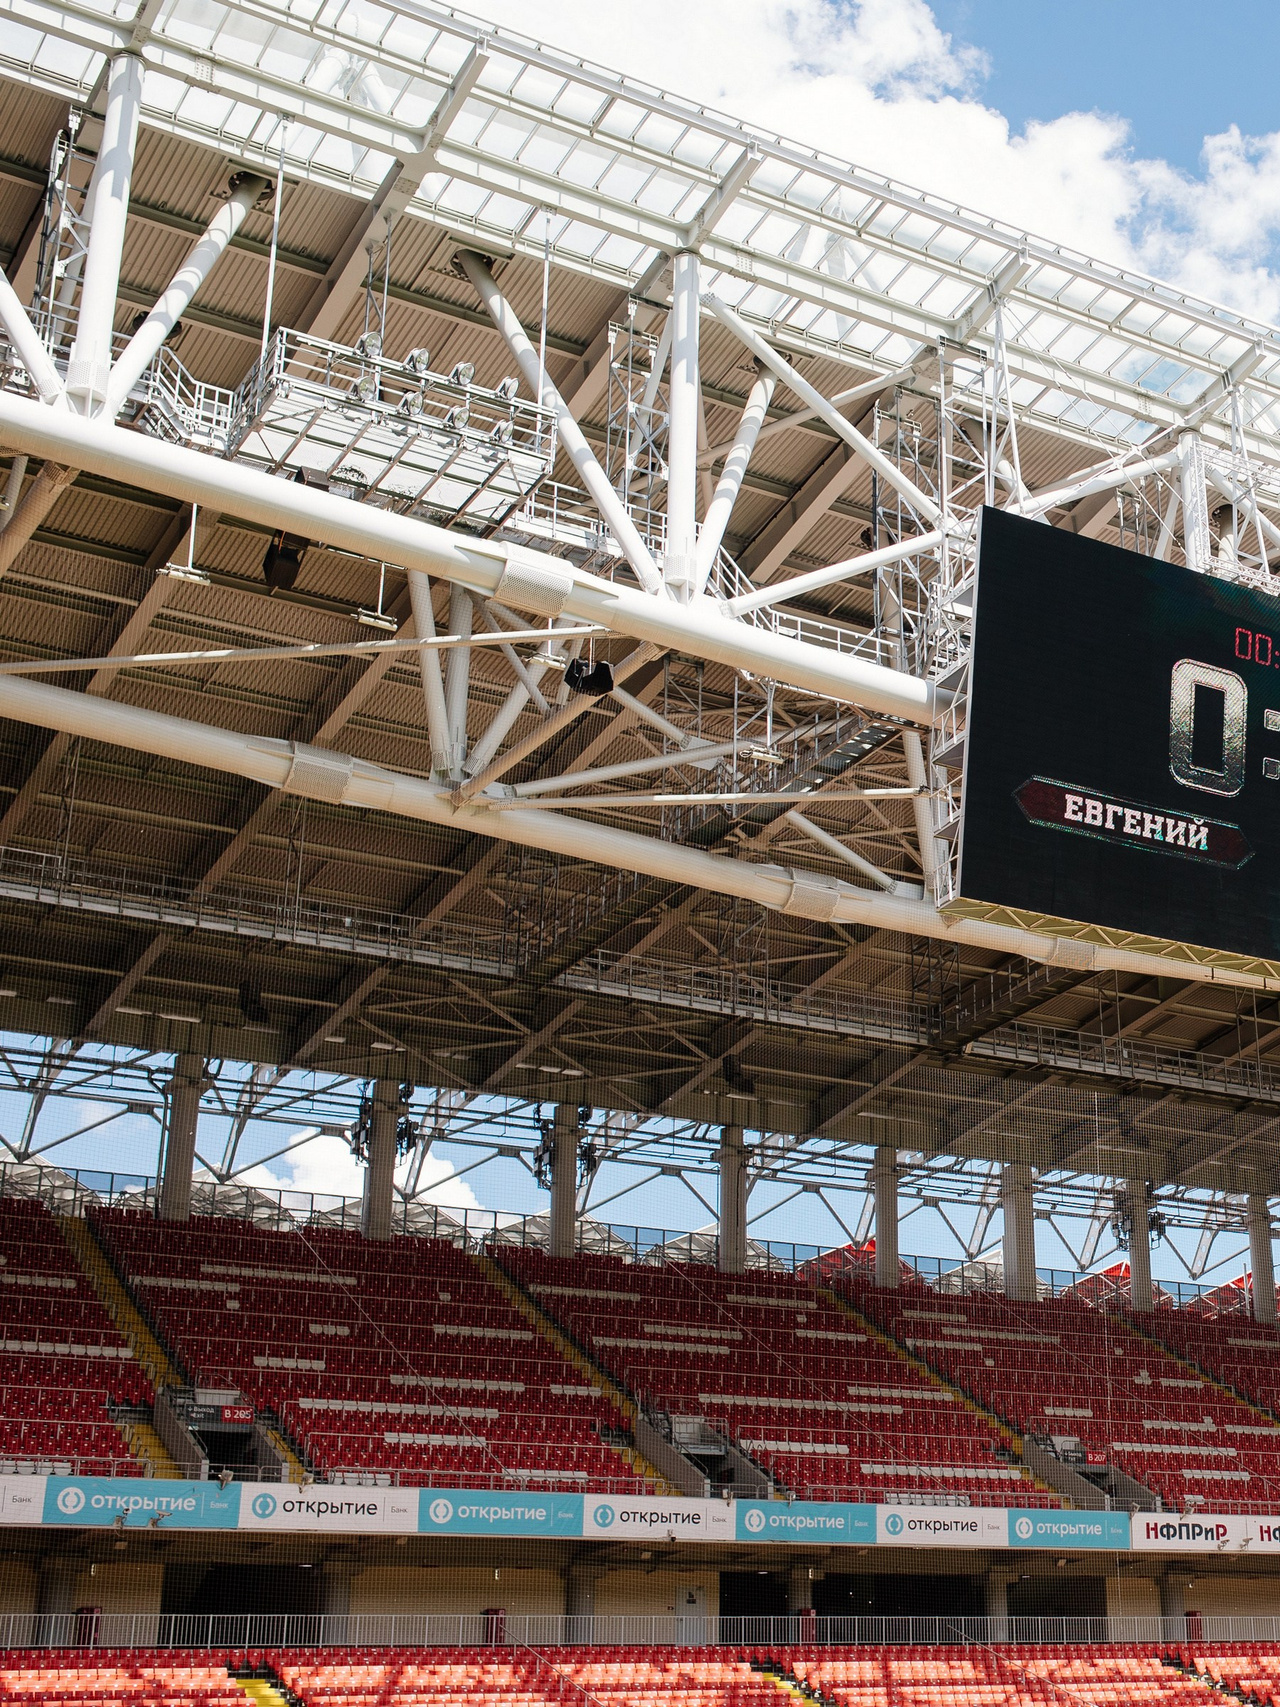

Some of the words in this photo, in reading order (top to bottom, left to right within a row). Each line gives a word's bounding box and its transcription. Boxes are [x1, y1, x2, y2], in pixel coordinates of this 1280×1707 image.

[1064, 794, 1209, 850] ЕВГЕНИЙ
[233, 1409, 251, 1419] 205
[12, 1495, 32, 1503] Банк
[91, 1494, 196, 1513] открытие
[210, 1501, 228, 1509] Банк
[282, 1498, 378, 1519] открытие
[457, 1504, 546, 1523] открытие
[619, 1510, 701, 1528] открытие
[769, 1514, 845, 1533] открытие
[907, 1517, 978, 1536] открытие
[1036, 1522, 1102, 1539] открытие
[1146, 1522, 1227, 1541] НФПРиР
